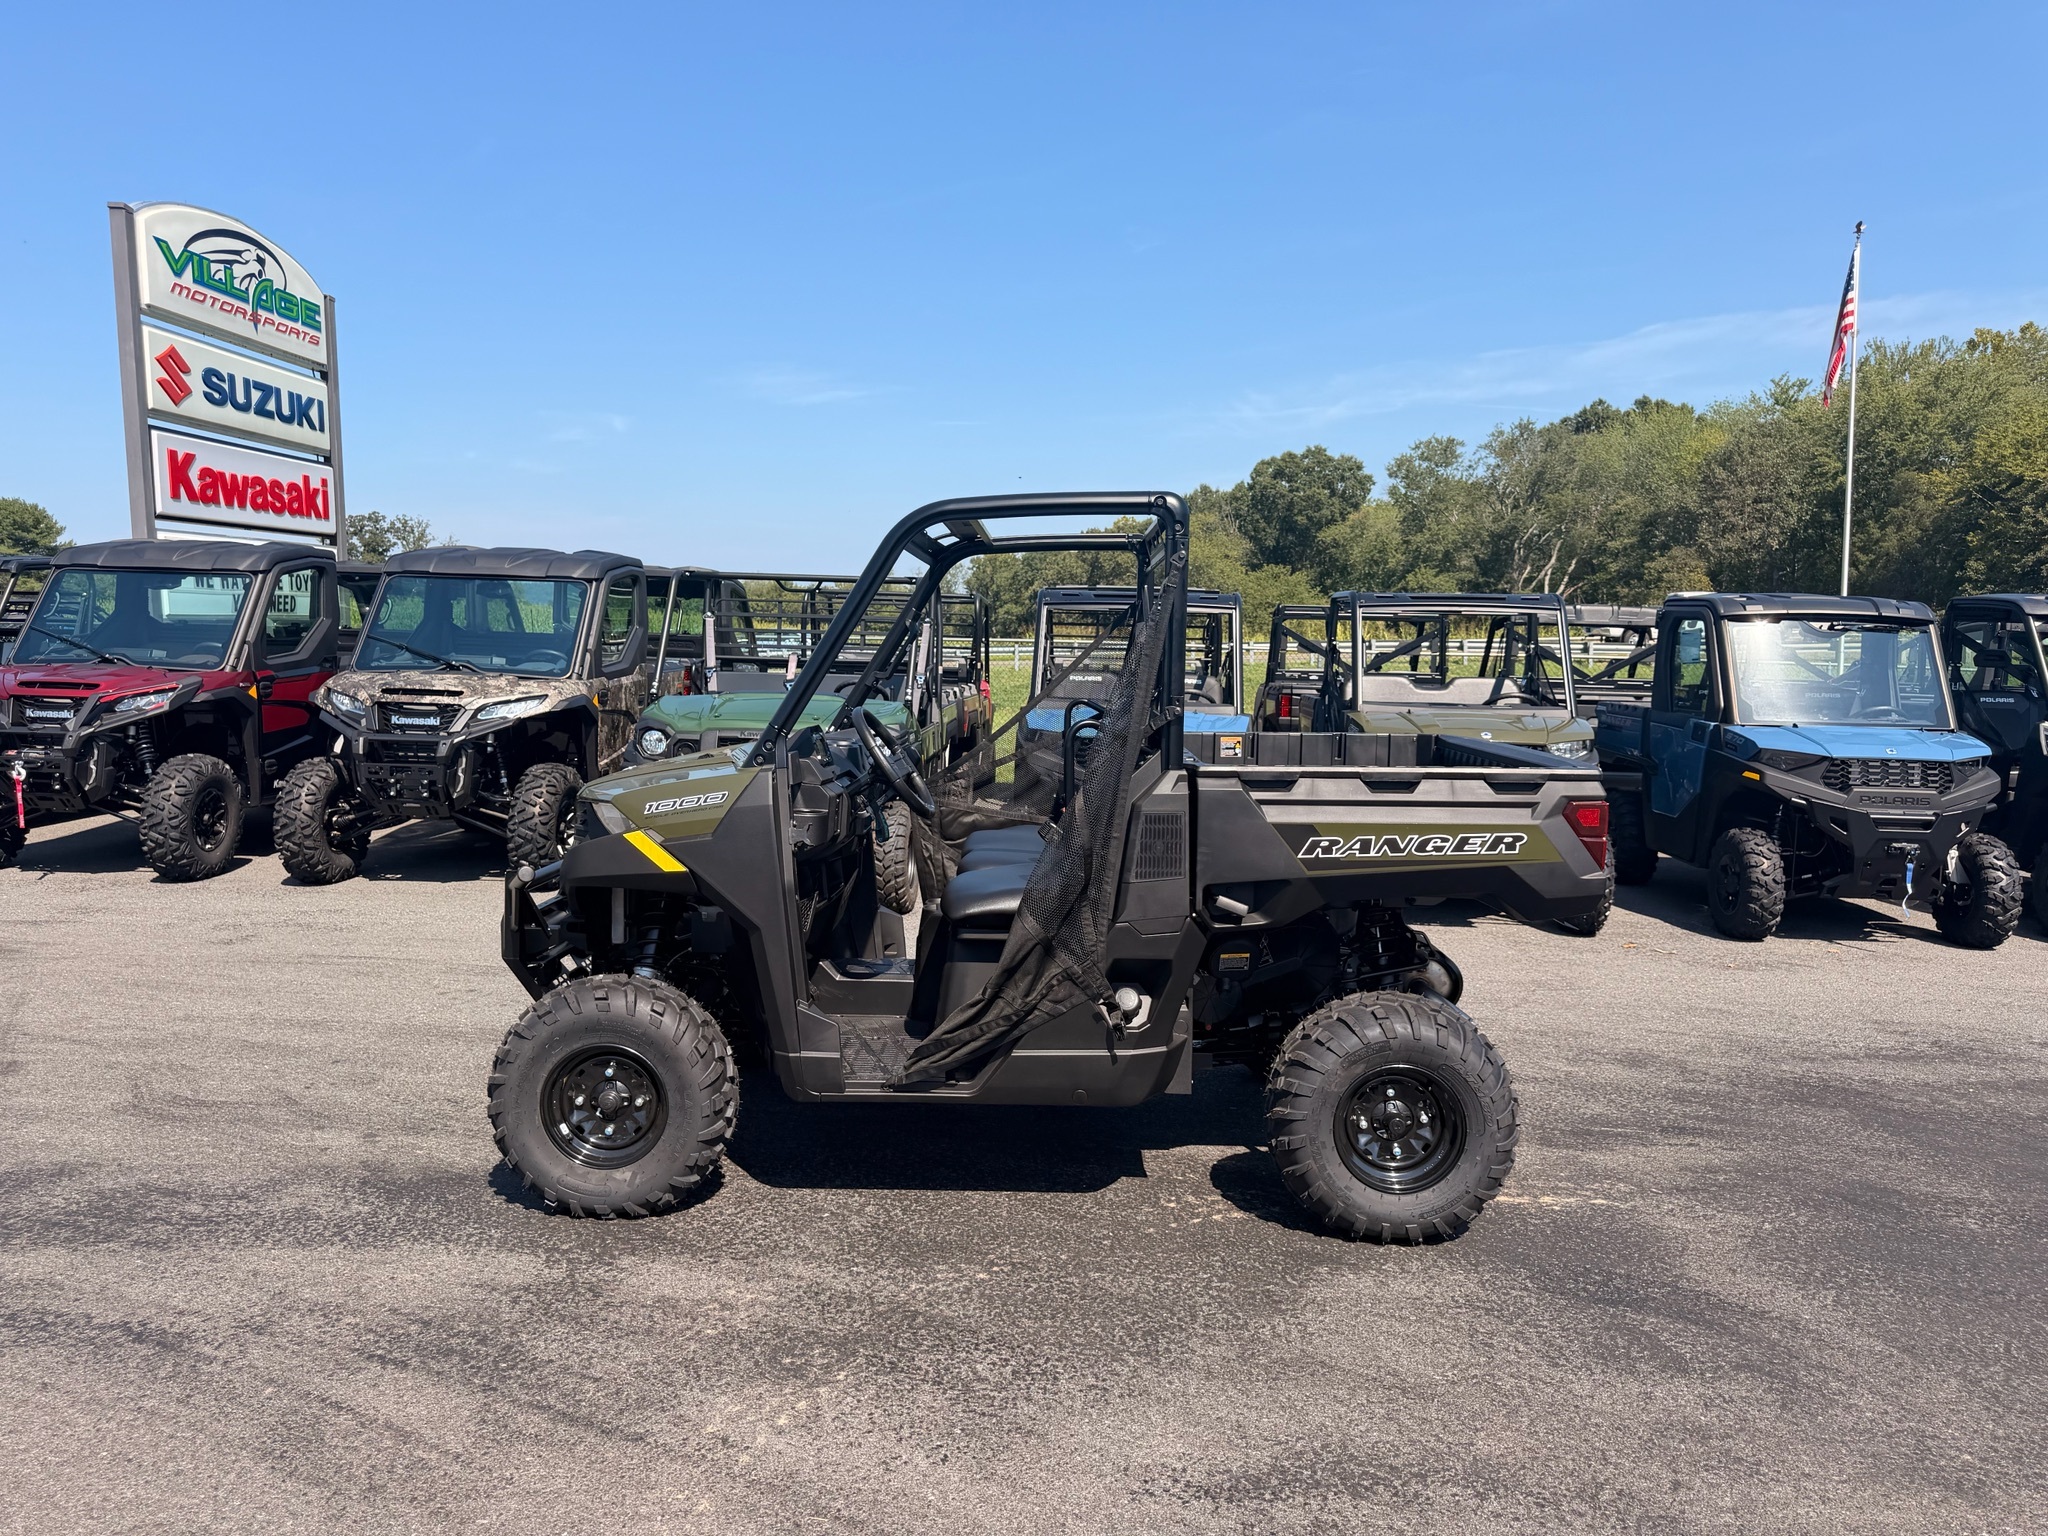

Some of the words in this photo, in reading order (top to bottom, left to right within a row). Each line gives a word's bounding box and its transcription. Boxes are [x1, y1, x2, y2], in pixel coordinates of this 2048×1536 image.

[152, 235, 322, 334] VILLAGE
[170, 280, 322, 347] MOTORSPORTS
[201, 367, 326, 434] SUZUKI
[166, 447, 330, 521] Kawasaki
[26, 708, 74, 719] Kawasaki
[391, 715, 440, 726] Kawasaki
[1725, 732, 1746, 745] 570
[643, 790, 730, 815] 1000
[1859, 795, 1932, 806] POLARIS
[1297, 832, 1527, 859] RANGER
